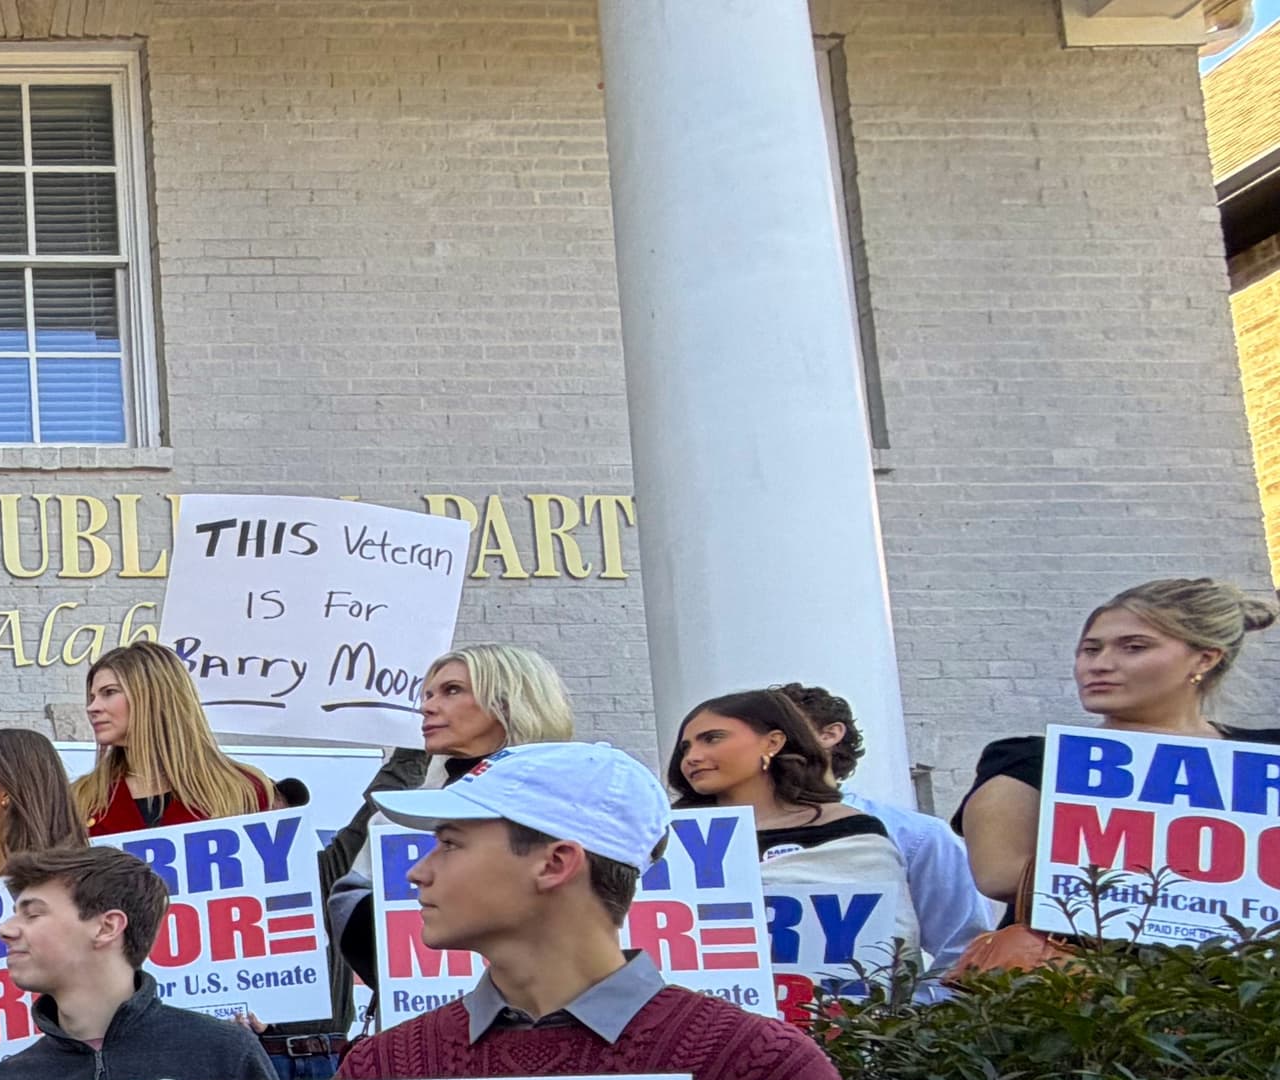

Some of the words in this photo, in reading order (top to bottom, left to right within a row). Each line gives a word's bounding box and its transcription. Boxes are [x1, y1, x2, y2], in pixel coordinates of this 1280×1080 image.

[196, 517, 320, 559] THIS
[343, 524, 452, 575] Veteran
[247, 590, 285, 620] IS
[324, 591, 388, 621] For
[328, 642, 423, 701] Moor
[1147, 923, 1172, 935] PAID
[184, 973, 228, 995] U.S.
[237, 965, 317, 991] Senate
